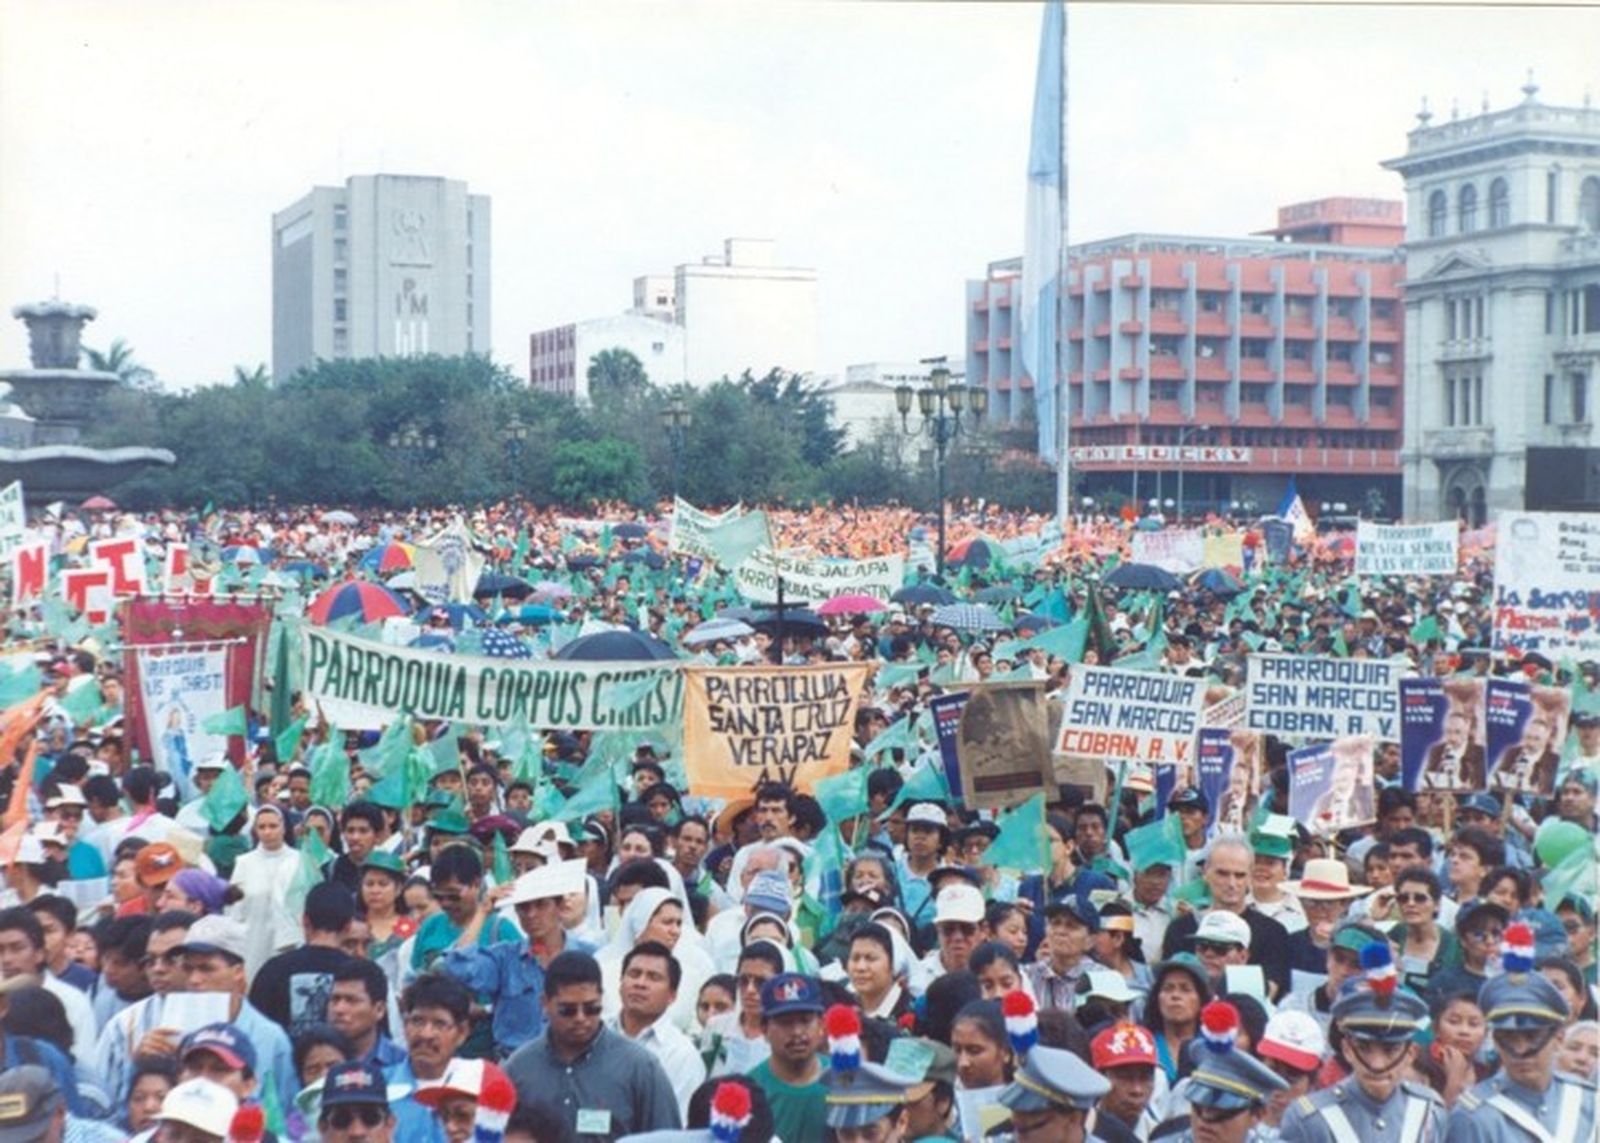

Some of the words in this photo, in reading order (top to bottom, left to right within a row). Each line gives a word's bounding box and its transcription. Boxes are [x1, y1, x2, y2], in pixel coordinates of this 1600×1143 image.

[1126, 446, 1246, 460] LUCKY
[820, 559, 890, 579] JALAPA
[309, 633, 467, 718] PARROQUIA
[476, 667, 586, 725] CORPUS
[705, 673, 849, 703] PARROQUIA
[1261, 658, 1390, 686] PARROQUIA
[1083, 671, 1195, 706] PARROQUIA
[1253, 683, 1298, 706] SAN
[1306, 686, 1397, 713] MARCOS
[708, 704, 785, 736] SANTA
[791, 698, 853, 733] CRUZ
[1070, 700, 1113, 727] SAN
[1117, 704, 1197, 735] MARCOS
[727, 731, 832, 766] VERAPAZ
